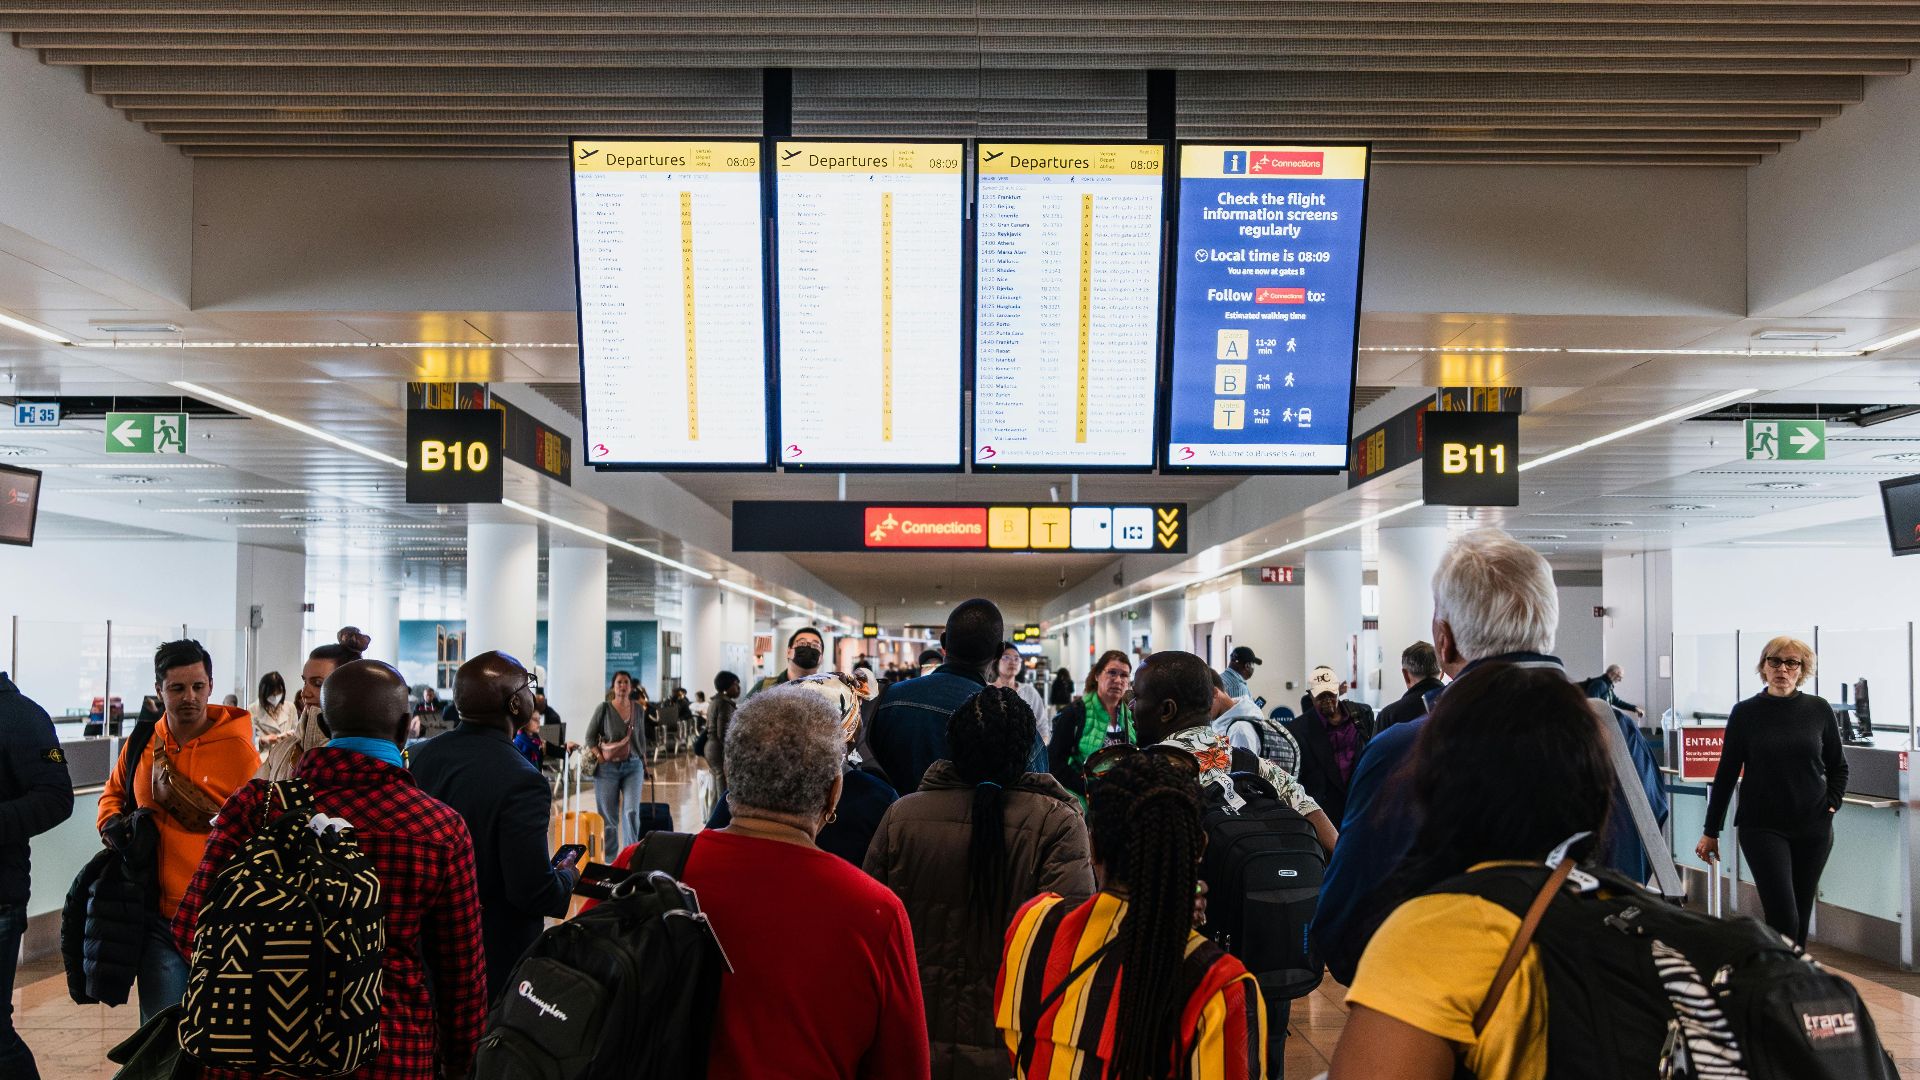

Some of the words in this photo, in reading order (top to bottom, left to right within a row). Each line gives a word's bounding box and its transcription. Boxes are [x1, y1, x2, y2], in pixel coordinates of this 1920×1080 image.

[606, 154, 686, 168] Departures
[726, 158, 756, 167] 08:09
[809, 154, 888, 169] Departures
[929, 158, 958, 168] 08:09
[1010, 155, 1090, 170] Departures
[1130, 160, 1159, 170] 08:09
[1272, 159, 1320, 168] Connections
[1217, 192, 1258, 205] Check
[1262, 192, 1284, 205] the
[1287, 192, 1326, 208] flight
[1203, 206, 1284, 221] information
[1286, 210, 1338, 222] screens
[1239, 224, 1302, 239] regularly
[1210, 249, 1246, 262] Local
[1249, 249, 1280, 262] time
[1283, 249, 1295, 262] is
[1298, 251, 1330, 263] 08:09
[1228, 267, 1241, 275] You
[1279, 268, 1299, 276] gates
[1208, 288, 1252, 302] Follow
[1307, 290, 1326, 302] to:
[1225, 312, 1260, 320] Estimated
[1261, 312, 1289, 321] walking
[1290, 312, 1306, 320] time
[1226, 340, 1238, 356] A
[1255, 339, 1277, 347] 11-20
[1258, 347, 1273, 355] min
[1224, 376, 1237, 392] B
[1258, 374, 1270, 382] 1-4
[40, 409, 55, 421] 35
[1223, 410, 1236, 426] T
[1253, 408, 1271, 416] 9-12
[421, 440, 489, 472] B10
[1442, 443, 1505, 474] B11
[901, 520, 982, 534] Connections
[1042, 522, 1058, 543] T
[518, 980, 568, 1022] Champion
[1803, 1013, 1857, 1034] trans
